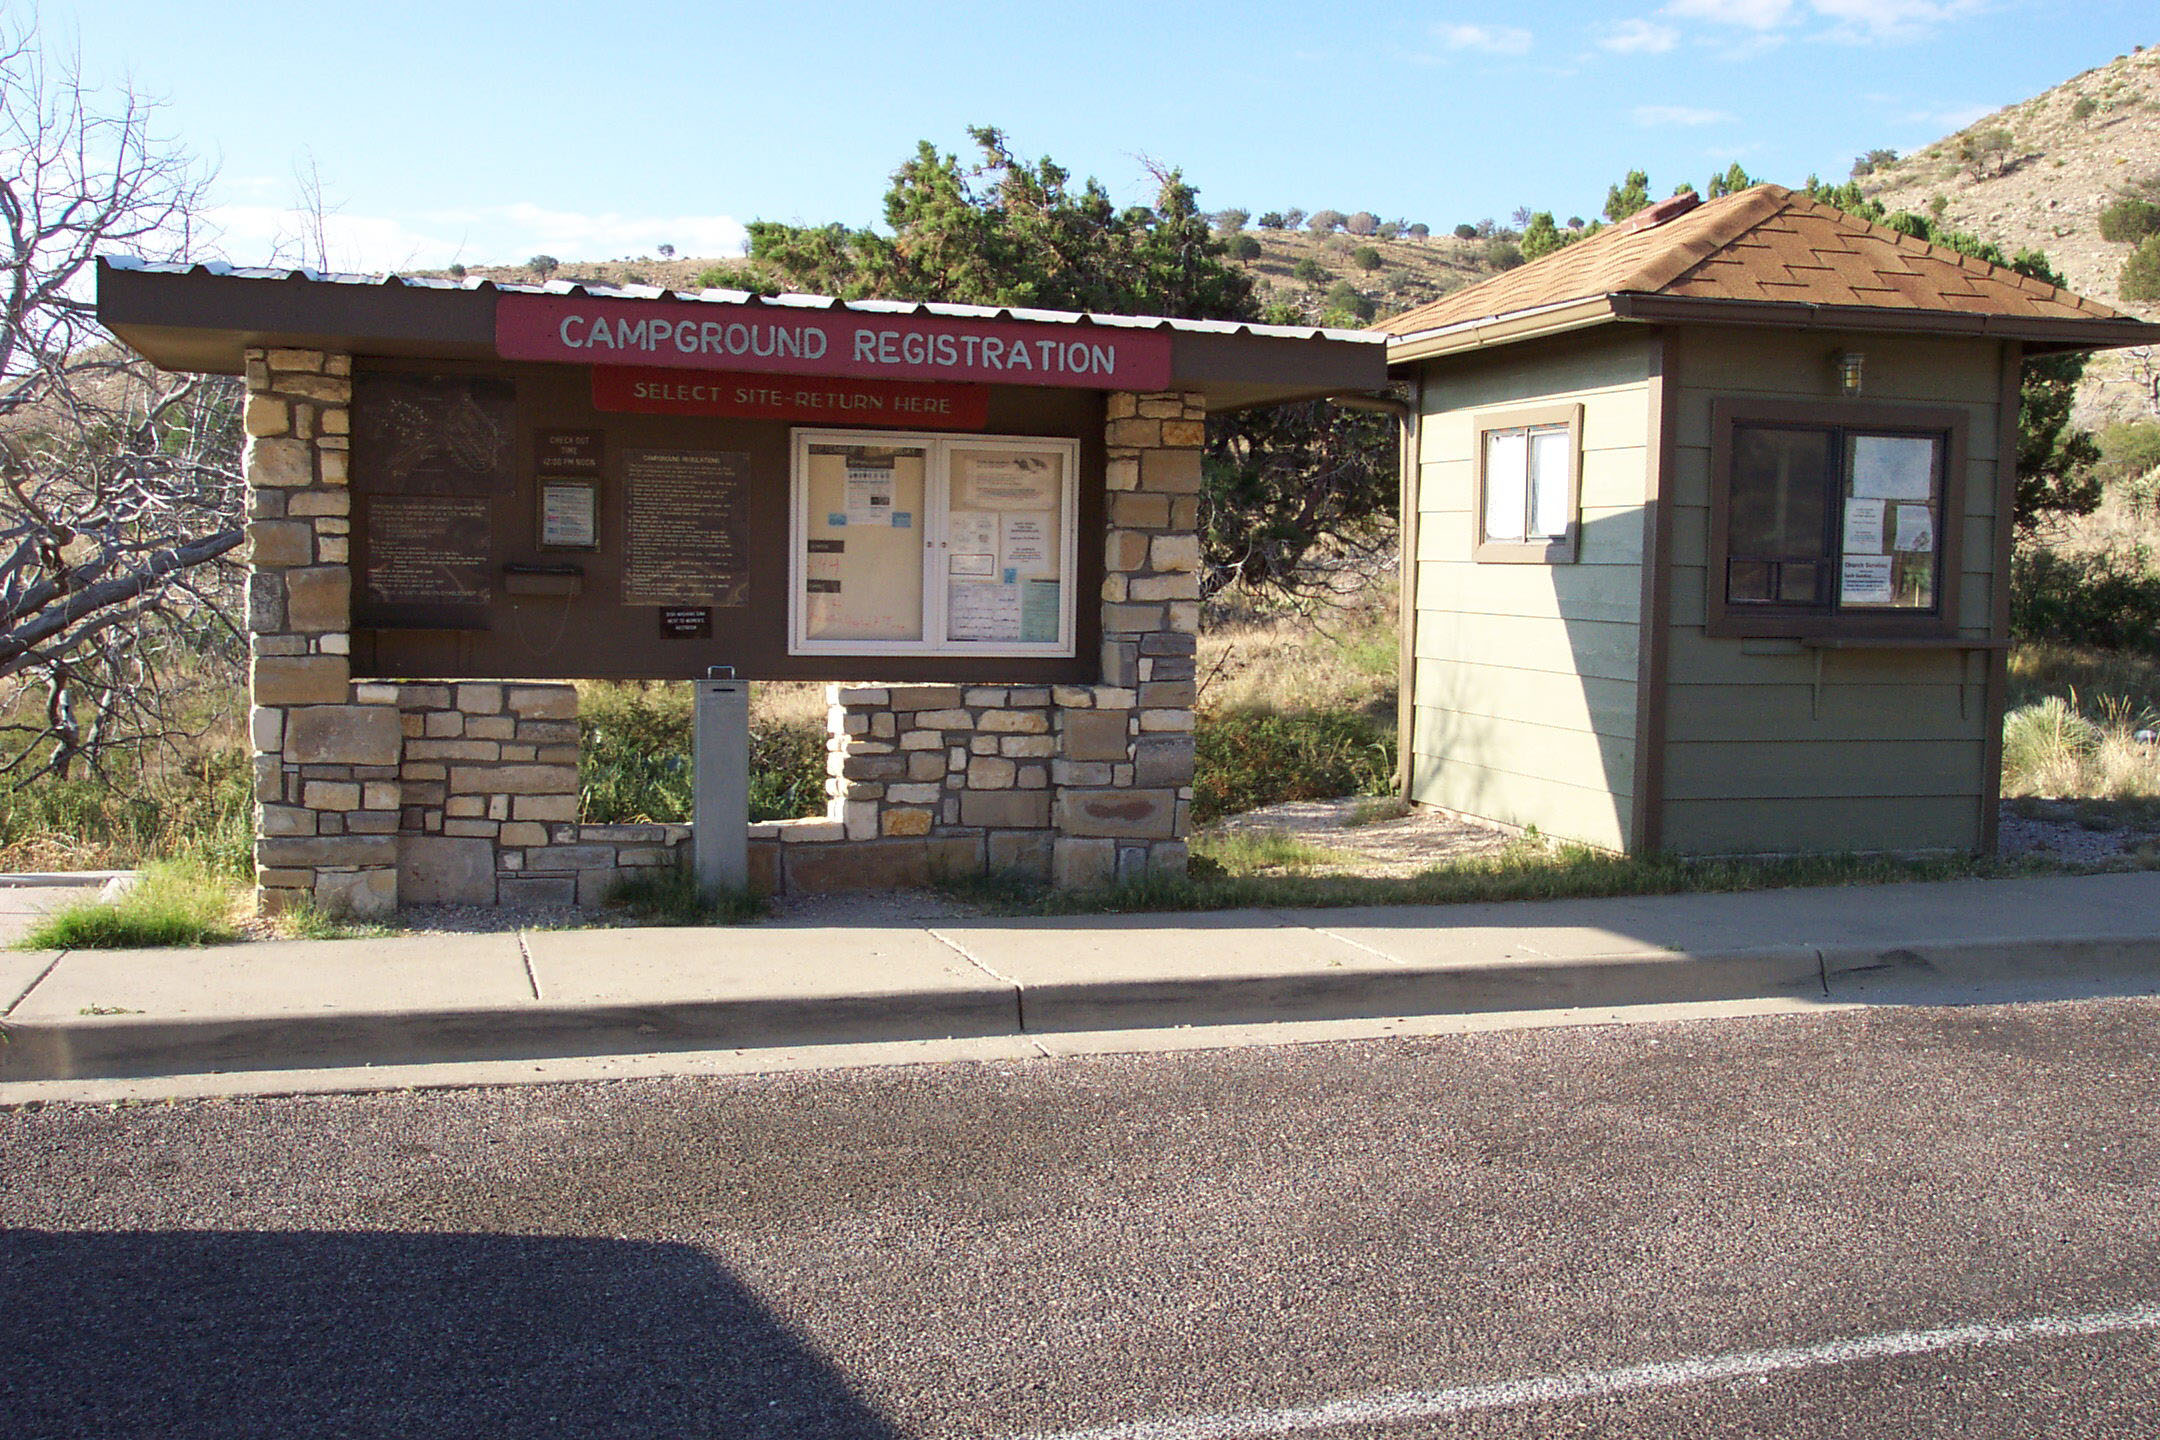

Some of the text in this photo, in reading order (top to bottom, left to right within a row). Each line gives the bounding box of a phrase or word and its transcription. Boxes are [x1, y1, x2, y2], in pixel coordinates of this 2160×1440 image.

[560, 315, 1116, 375] CAMPGROUND REGISTRATION
[633, 382, 721, 402] SELECT
[894, 395, 952, 414] HERE
